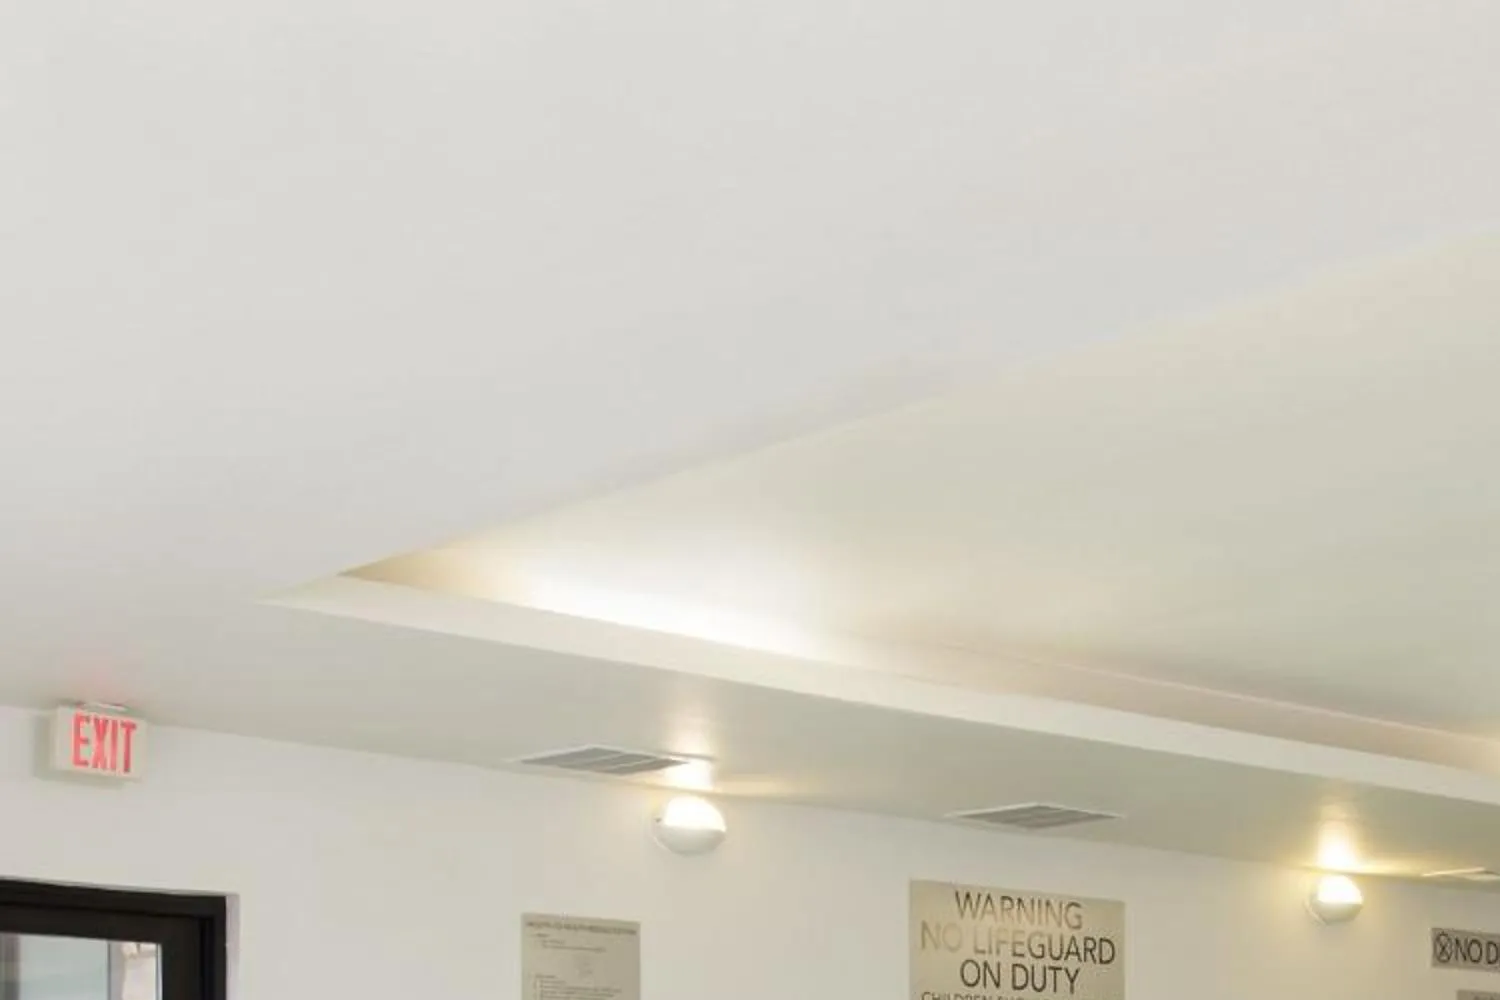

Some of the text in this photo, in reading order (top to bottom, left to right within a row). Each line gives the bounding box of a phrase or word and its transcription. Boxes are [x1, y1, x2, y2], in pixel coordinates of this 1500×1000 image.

[73, 712, 137, 774] EXIT
[955, 891, 1083, 930] WARNING
[920, 920, 1116, 965] NO LIFEGUARD
[1454, 936, 1483, 964] NO
[960, 959, 1080, 994] ON DUTY
